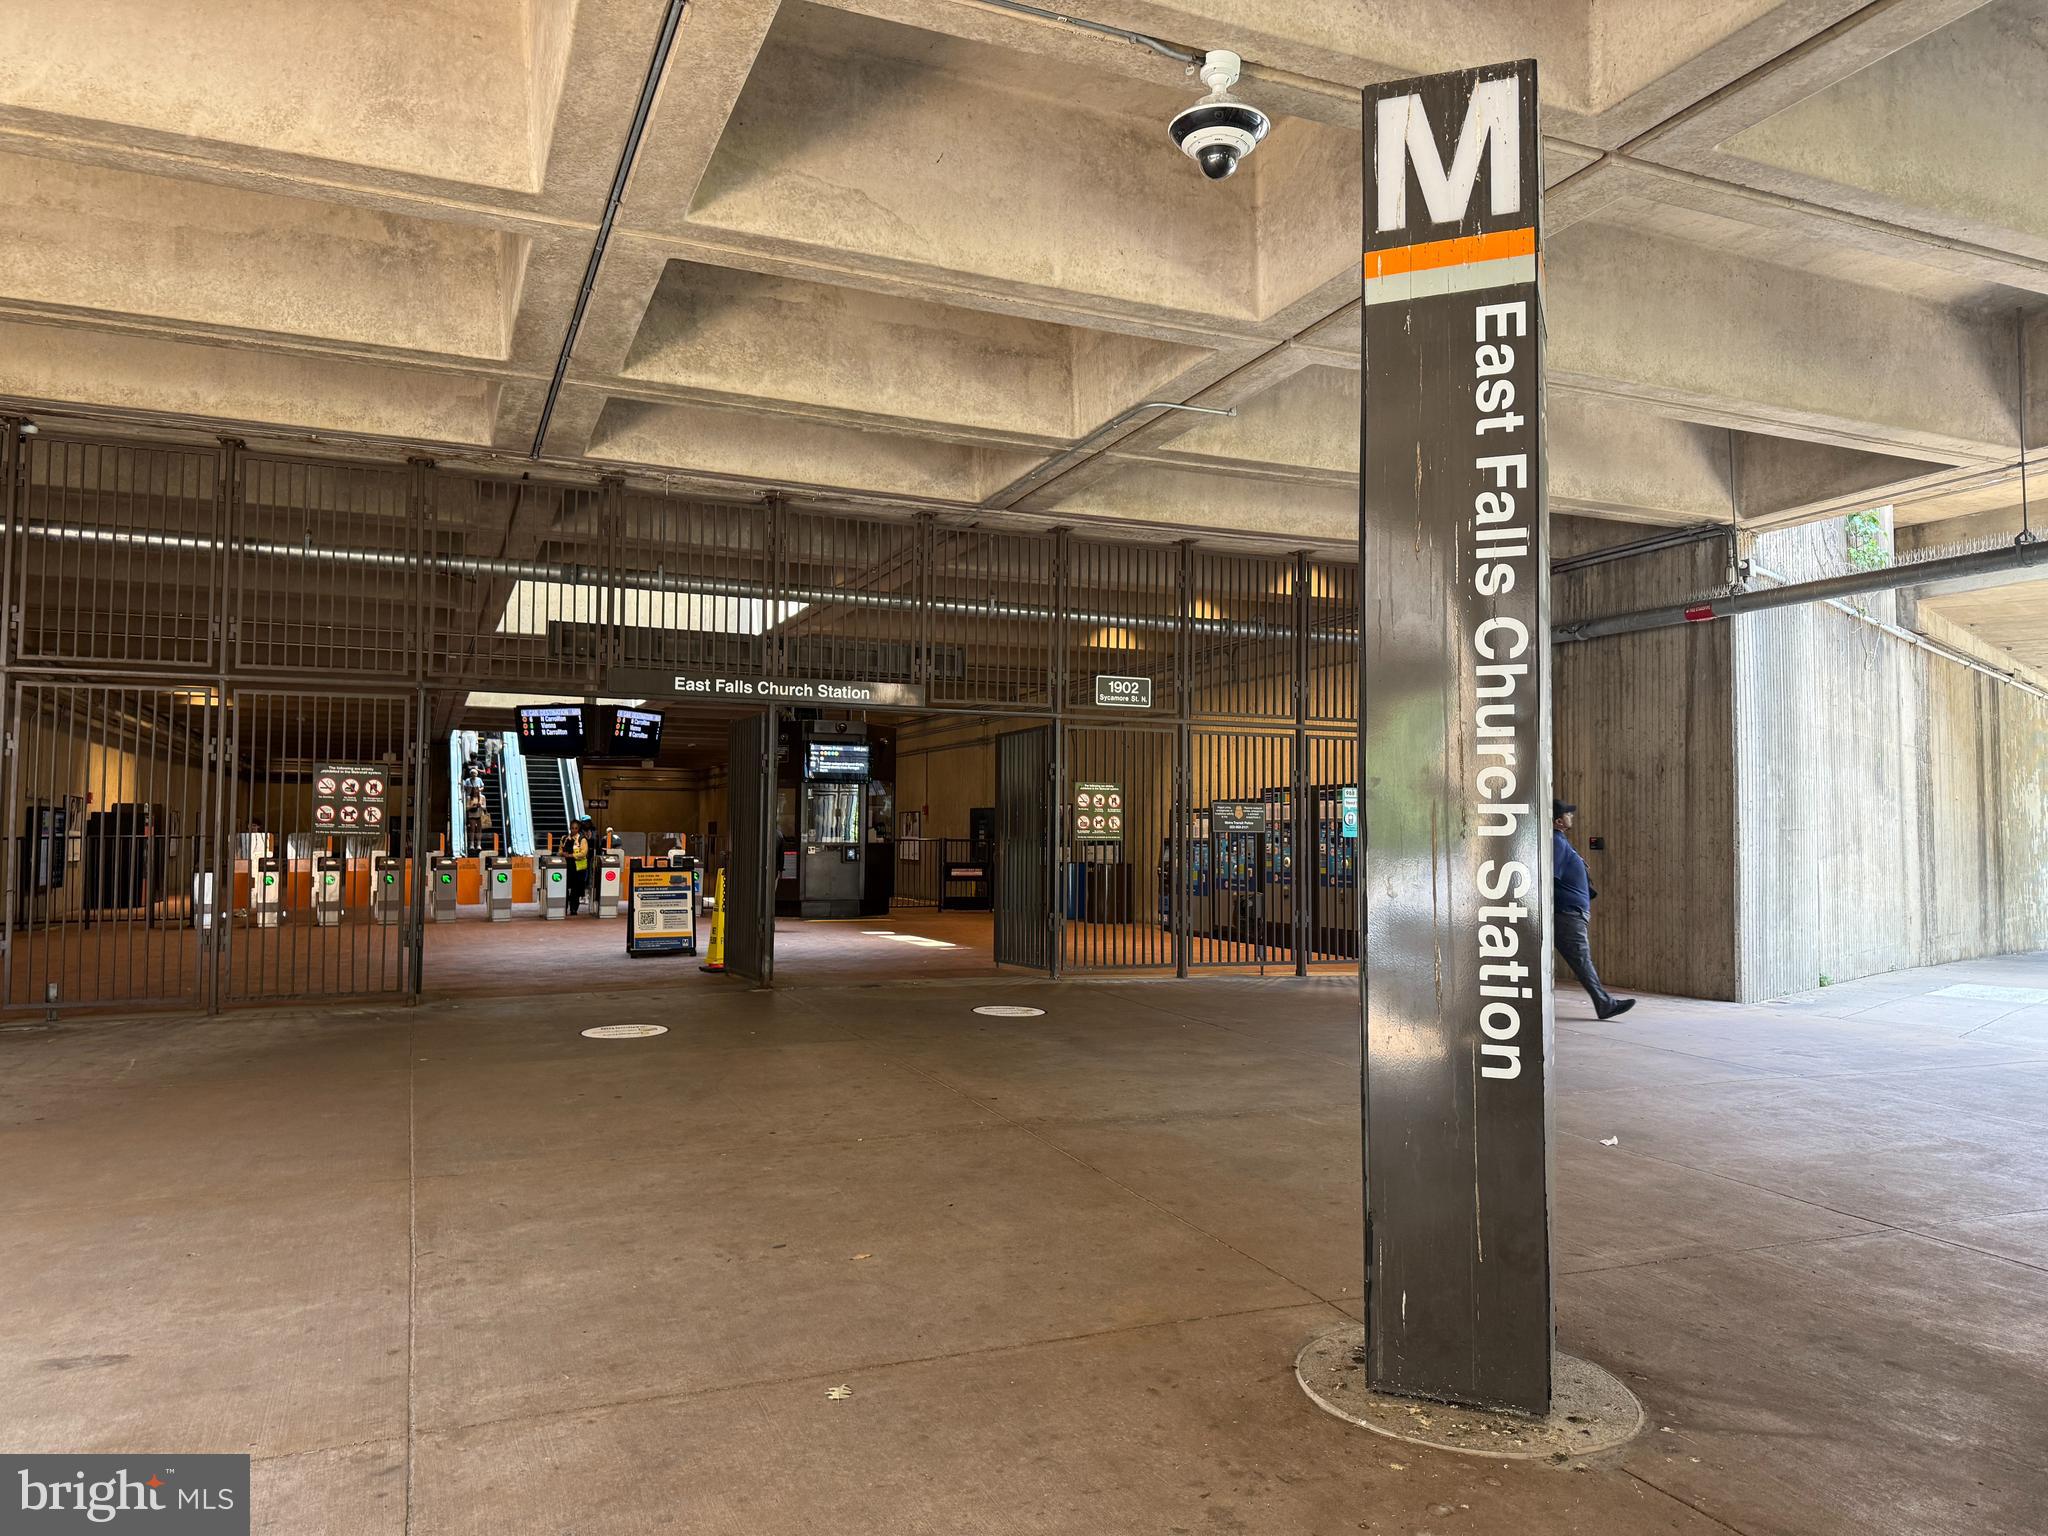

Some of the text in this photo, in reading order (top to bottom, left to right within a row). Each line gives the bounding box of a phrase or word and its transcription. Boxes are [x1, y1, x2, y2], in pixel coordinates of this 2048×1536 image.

[1376, 77, 1520, 232] M
[674, 677, 870, 699] East Falls Church Station
[1099, 693, 1129, 702] Sycamore
[1108, 681, 1139, 694] 1902
[1475, 301, 1533, 1080] East Falls Church Station
